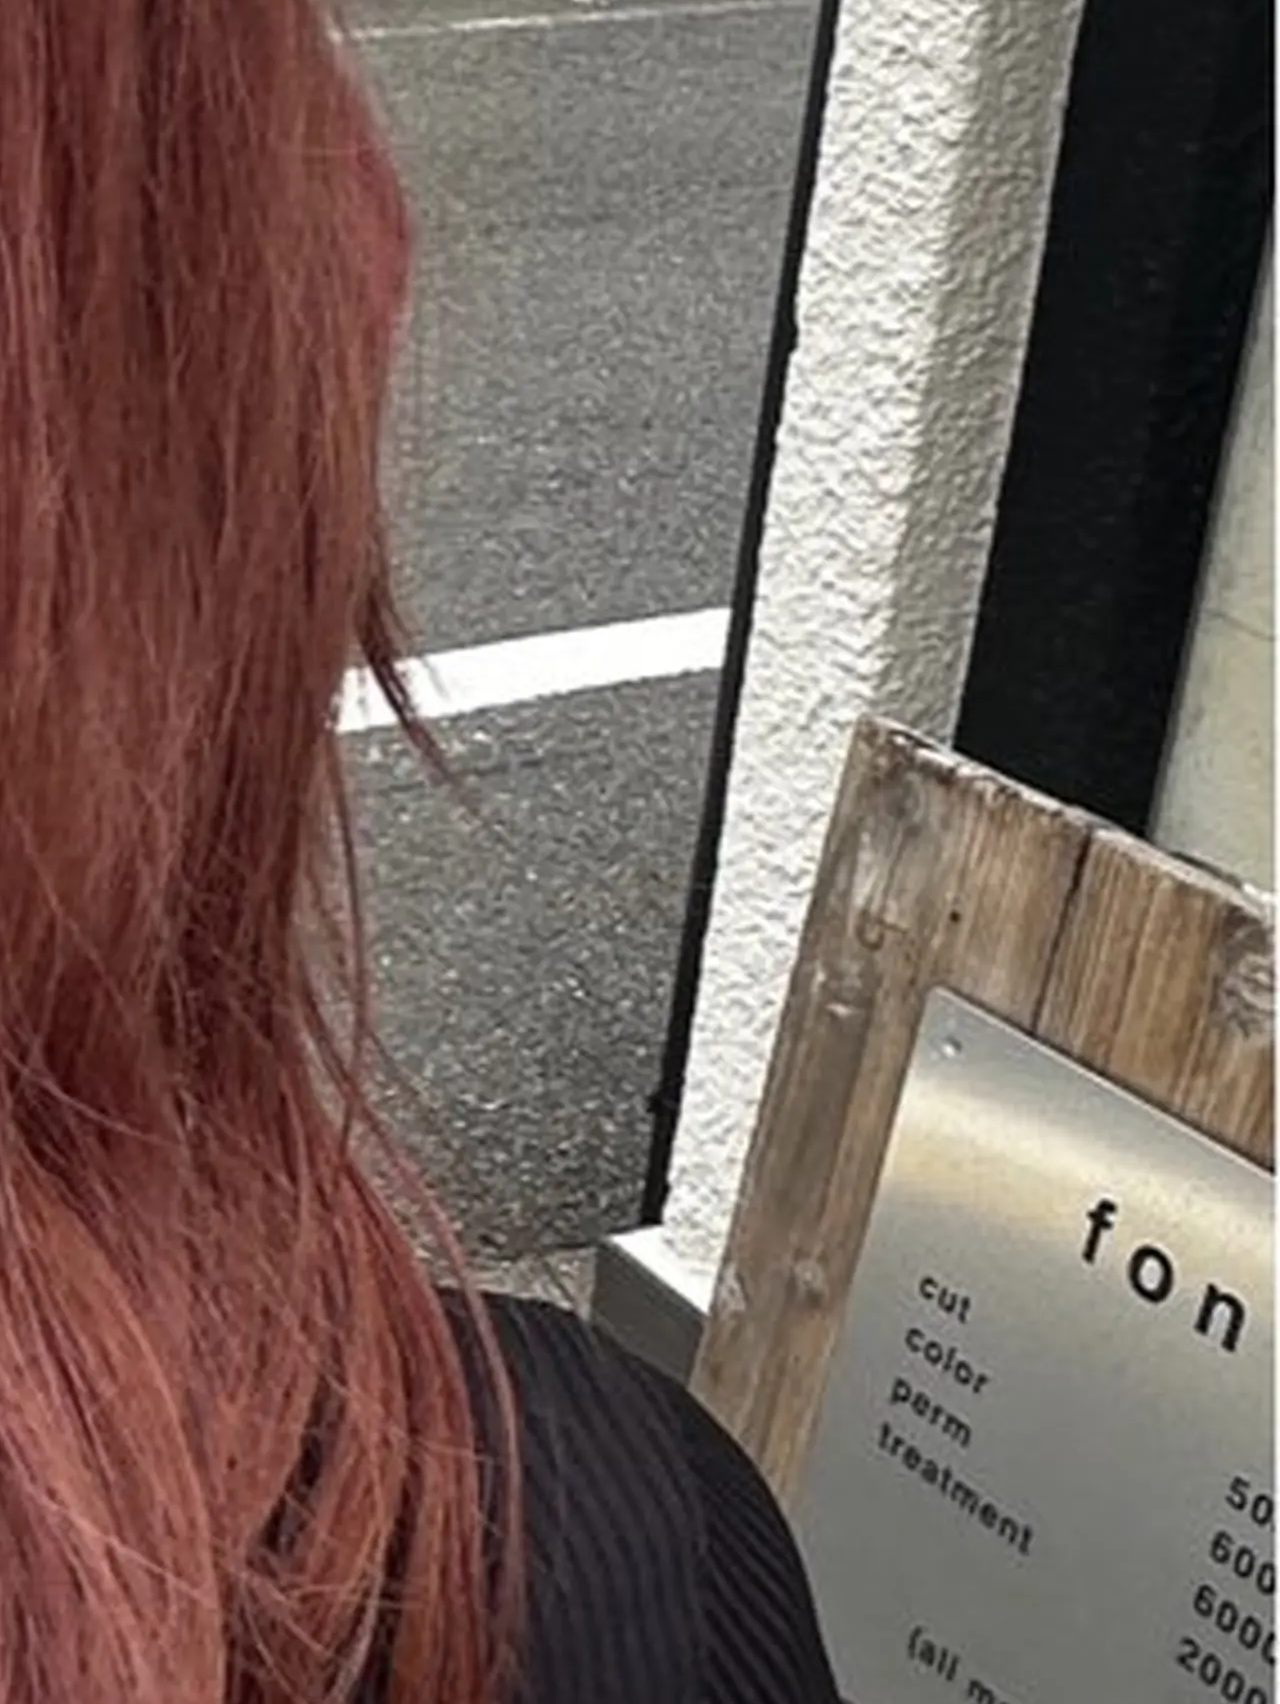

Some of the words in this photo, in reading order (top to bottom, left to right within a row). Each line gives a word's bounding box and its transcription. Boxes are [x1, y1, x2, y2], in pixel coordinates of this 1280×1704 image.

[1082, 1198, 1246, 1352] fon
[905, 1327, 989, 1393] color
[919, 1276, 971, 1324] cut
[1225, 1475, 1275, 1533] 50
[890, 1376, 972, 1448] perm
[878, 1421, 1033, 1556] treatment
[908, 1626, 960, 1681] (all
